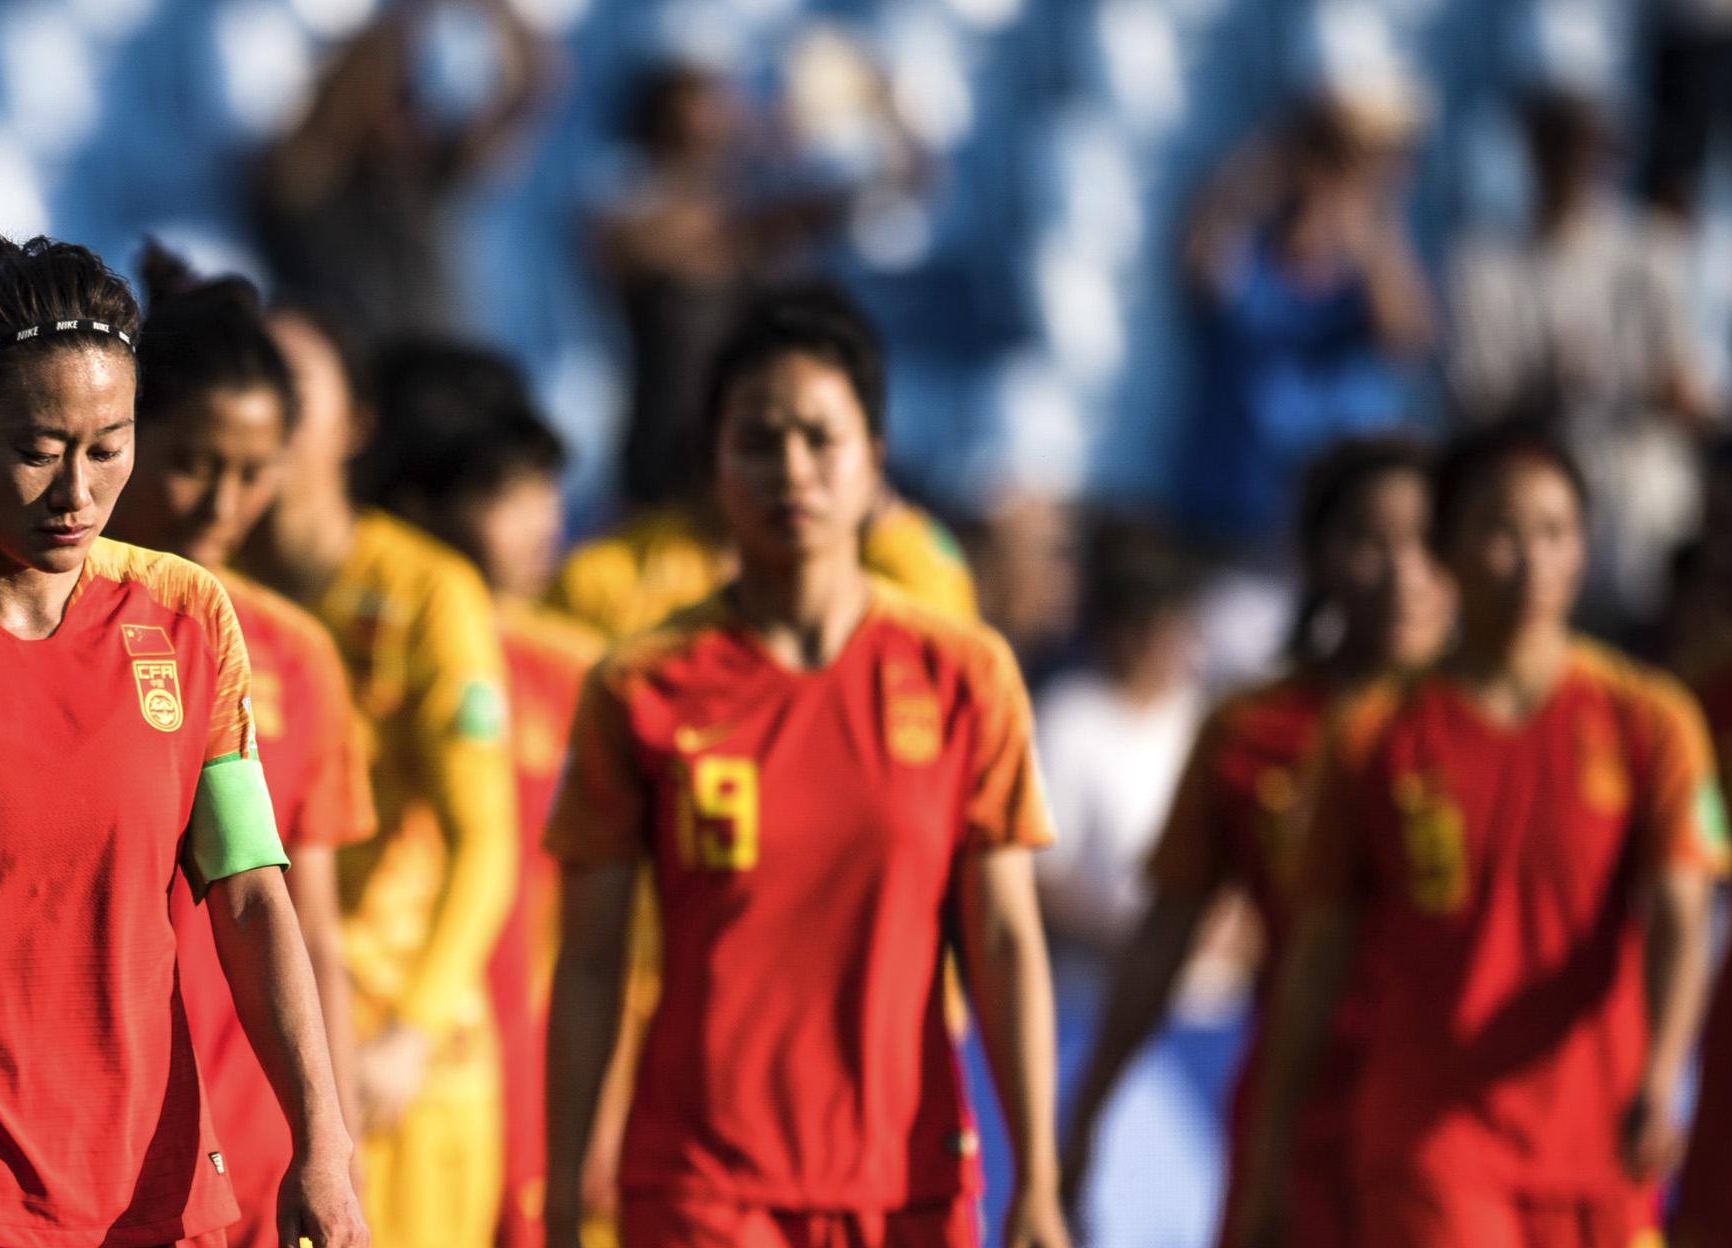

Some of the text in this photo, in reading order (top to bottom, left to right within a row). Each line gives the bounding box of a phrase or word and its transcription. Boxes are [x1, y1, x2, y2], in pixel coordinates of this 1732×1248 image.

[16, 326, 39, 340] NIKE
[56, 320, 78, 330] NIKE
[137, 665, 173, 680] CFA
[670, 756, 759, 871] 19
